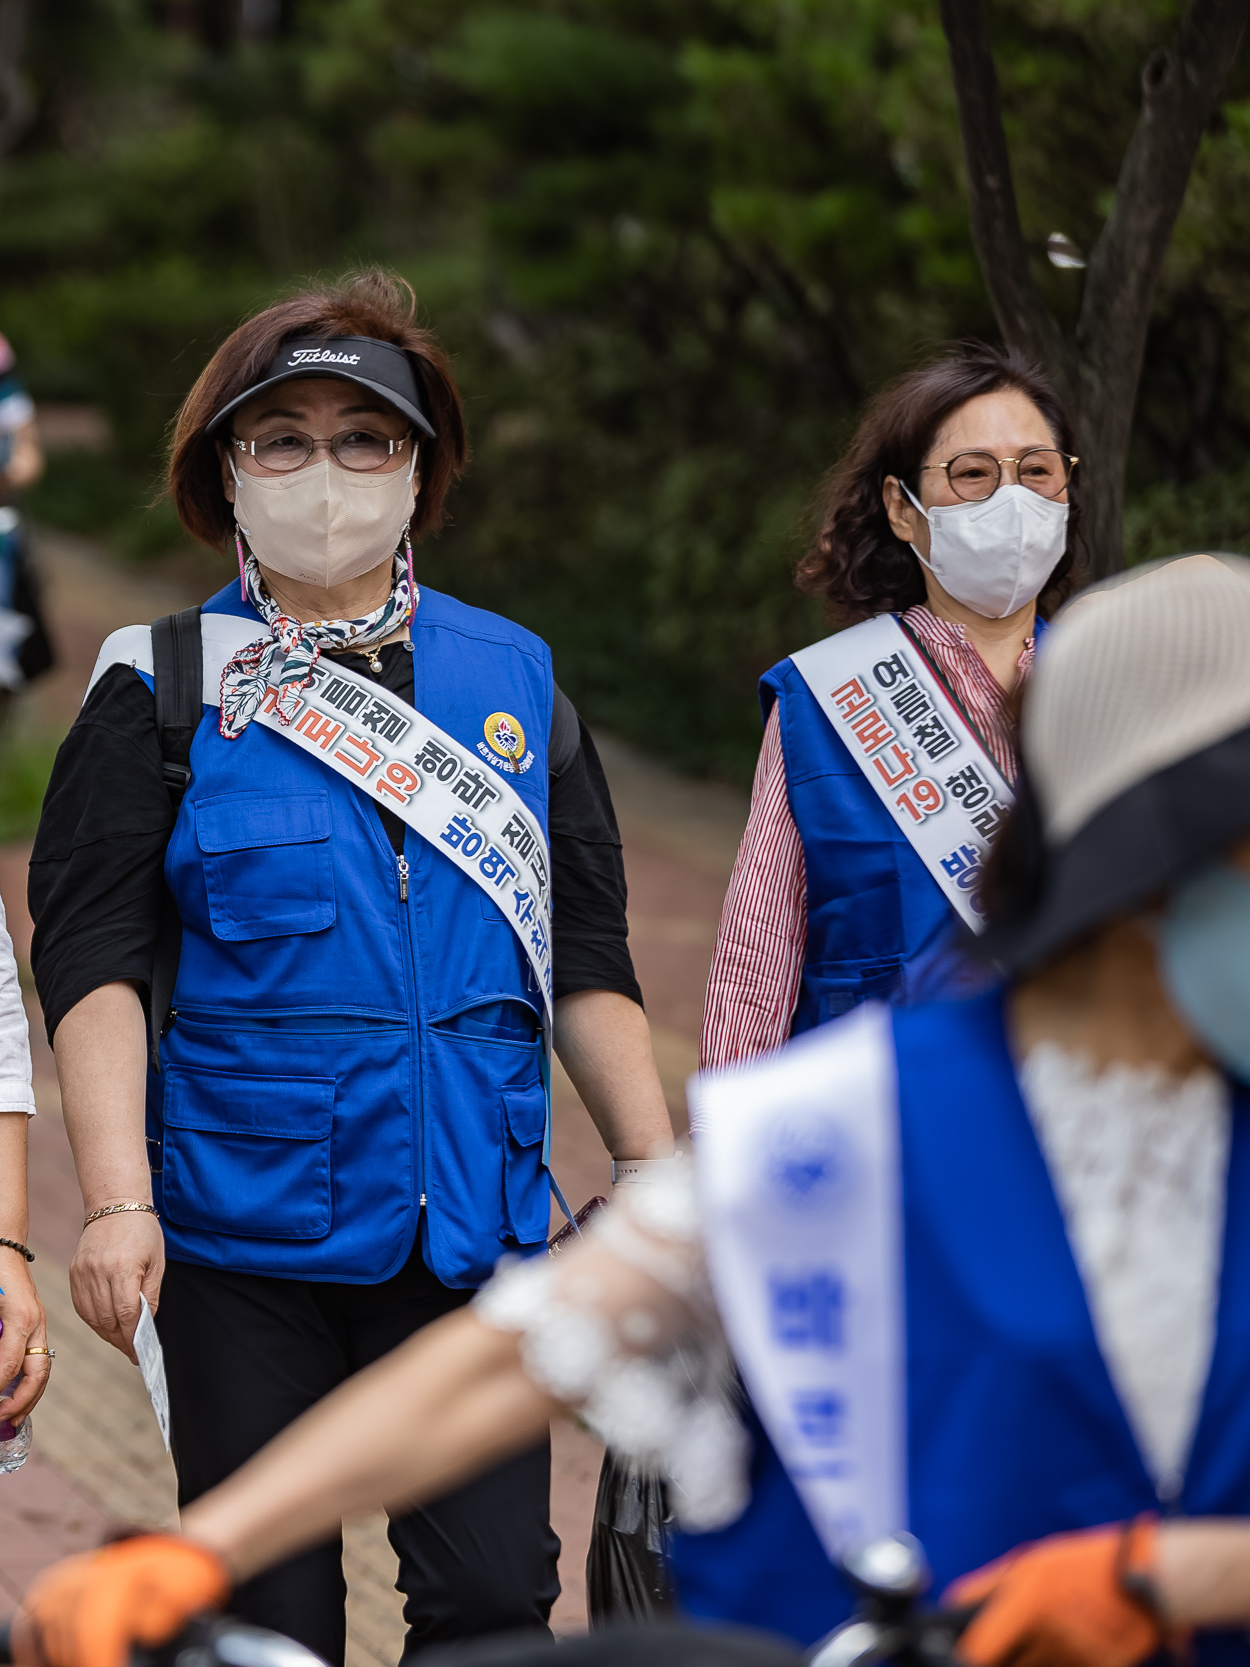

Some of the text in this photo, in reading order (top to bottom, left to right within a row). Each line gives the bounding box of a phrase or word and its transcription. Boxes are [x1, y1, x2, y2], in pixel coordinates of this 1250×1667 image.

[287, 347, 361, 366] Titleist
[831, 677, 940, 820] 코로나19
[873, 654, 957, 759] 여름철
[415, 740, 497, 810] 행락
